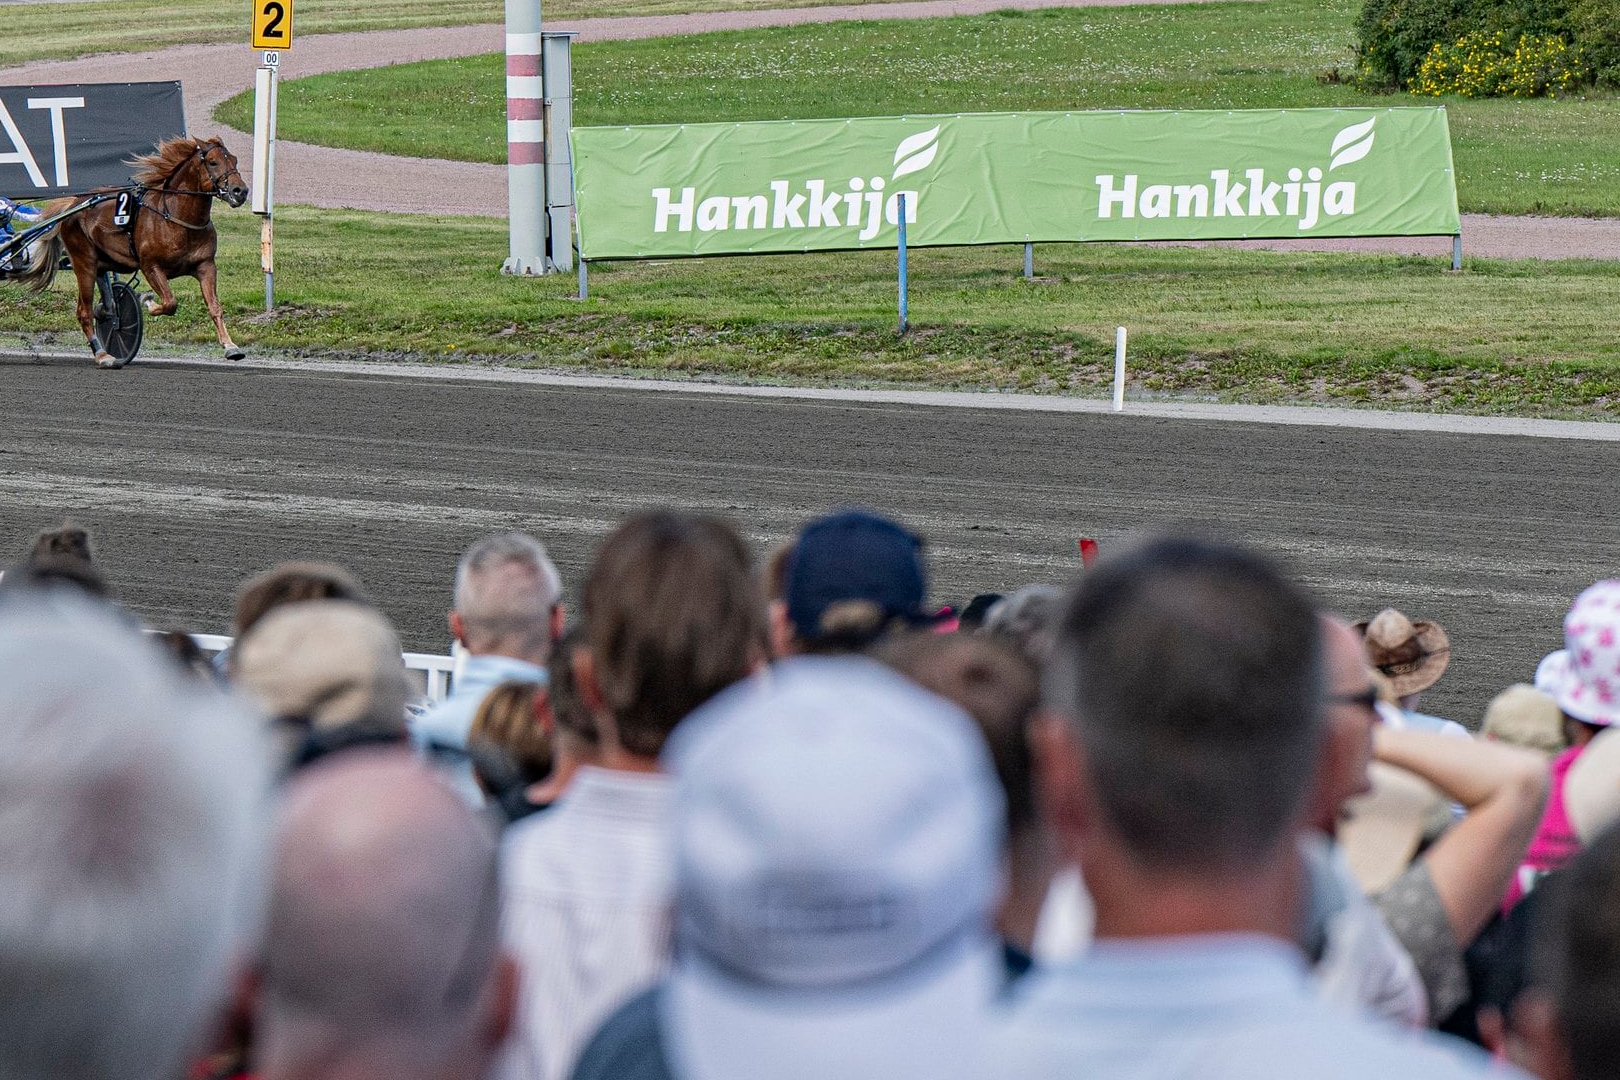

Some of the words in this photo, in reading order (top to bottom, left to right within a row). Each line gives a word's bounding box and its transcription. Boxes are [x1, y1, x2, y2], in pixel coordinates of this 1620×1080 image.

[262, 1, 284, 38] 2
[266, 53, 277, 64] 00
[118, 192, 128, 216] 2
[651, 176, 918, 240] Hankkija
[1095, 166, 1357, 229] Hankkija
